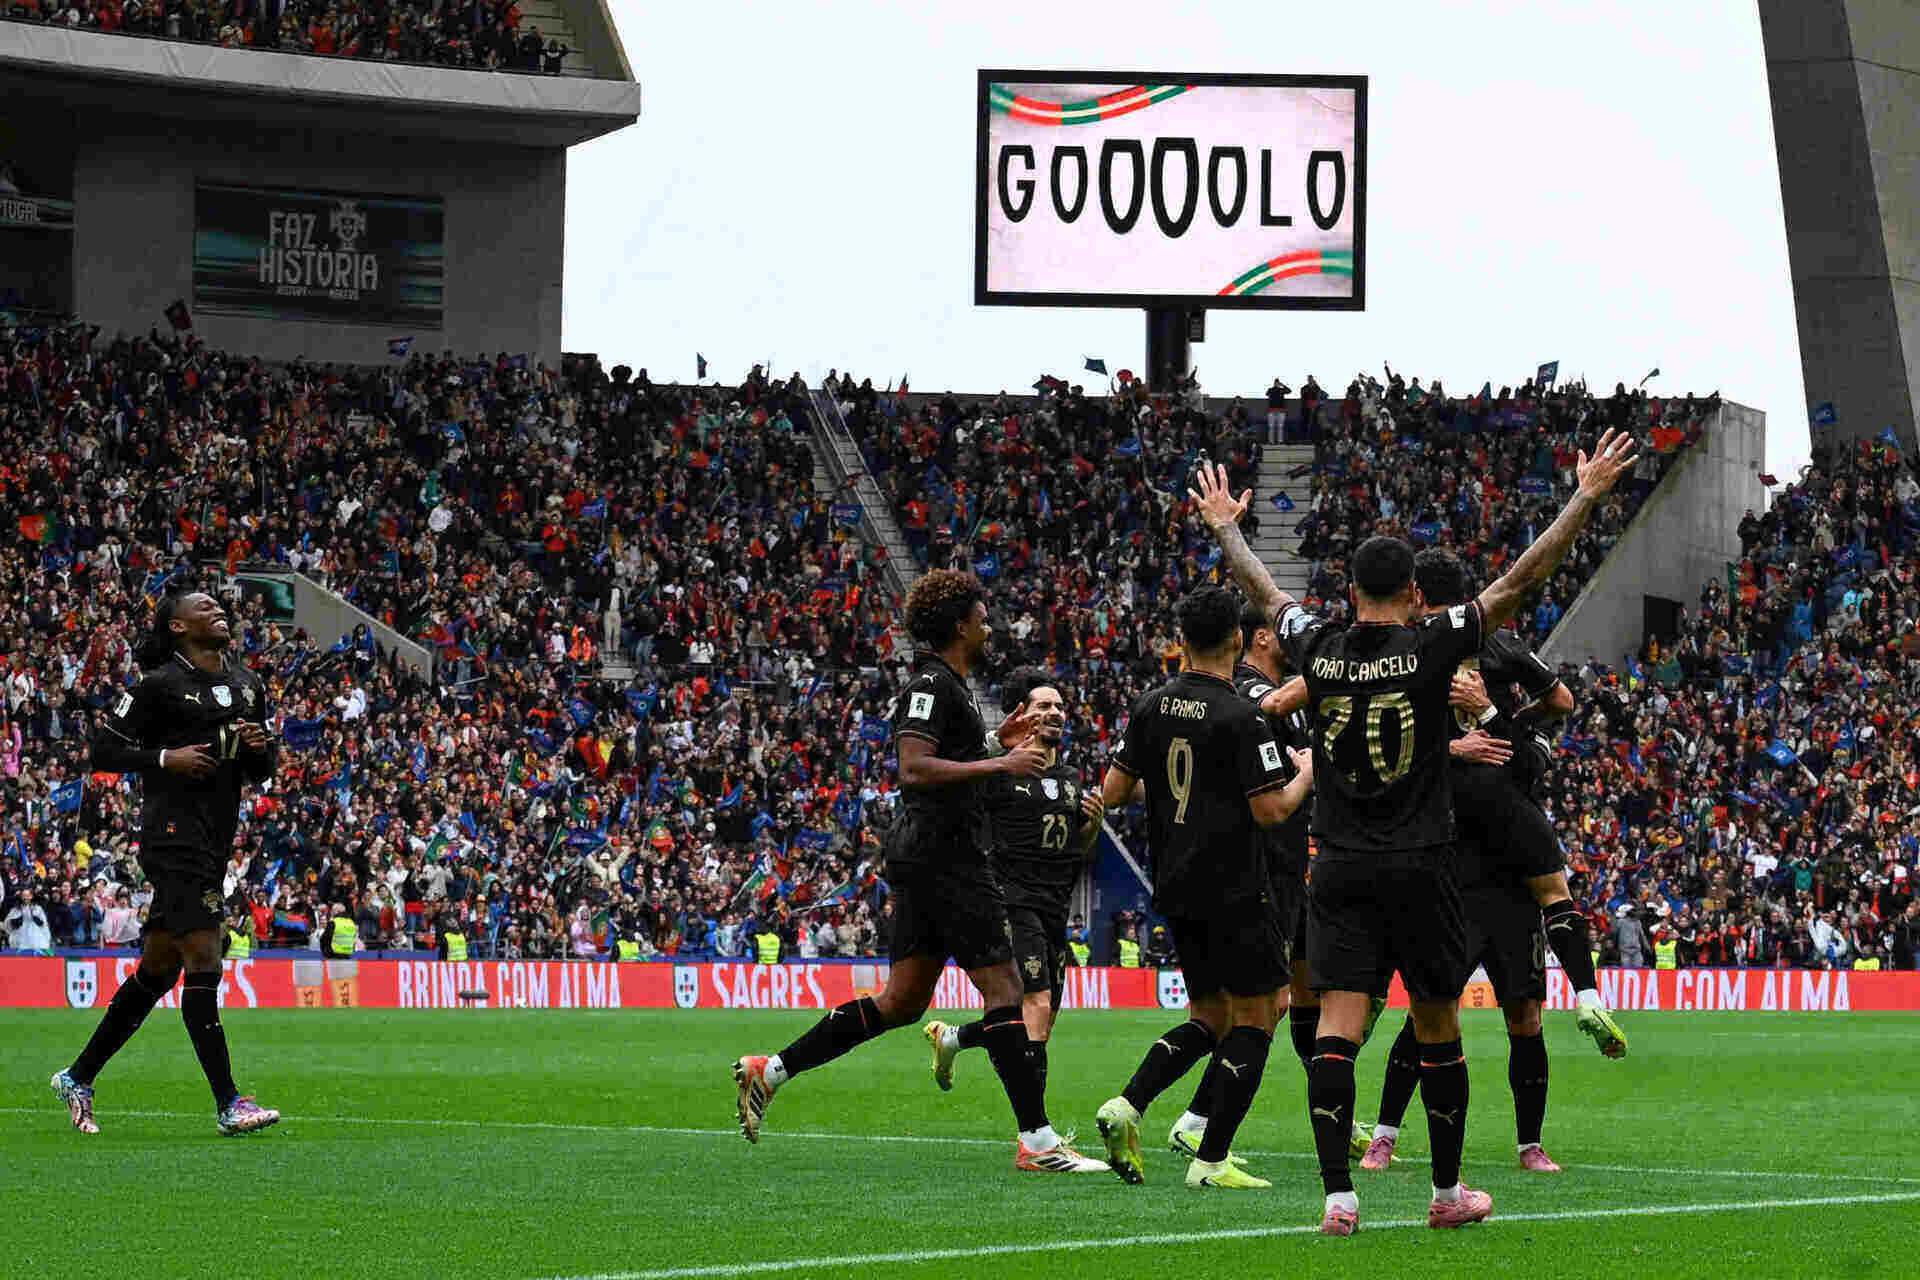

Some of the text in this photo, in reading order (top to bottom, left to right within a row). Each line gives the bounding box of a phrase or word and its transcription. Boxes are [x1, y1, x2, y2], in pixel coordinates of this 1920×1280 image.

[997, 137, 1346, 238] GOOOOLO
[268, 210, 317, 249] FAZ
[258, 242, 379, 290] HISTÓRIA
[1348, 654, 1418, 681] CANCELO
[1170, 698, 1208, 720] RAMOS
[1319, 691, 1415, 783] 20
[1167, 737, 1193, 824] 9
[1041, 813, 1069, 850] 23
[398, 962, 487, 1008] BRINDA
[497, 962, 549, 1008] COM
[559, 963, 621, 1008] ALMA
[712, 964, 825, 1008] SAGRES
[1675, 969, 1746, 1010] COM
[1760, 970, 1850, 1010] ALMA
